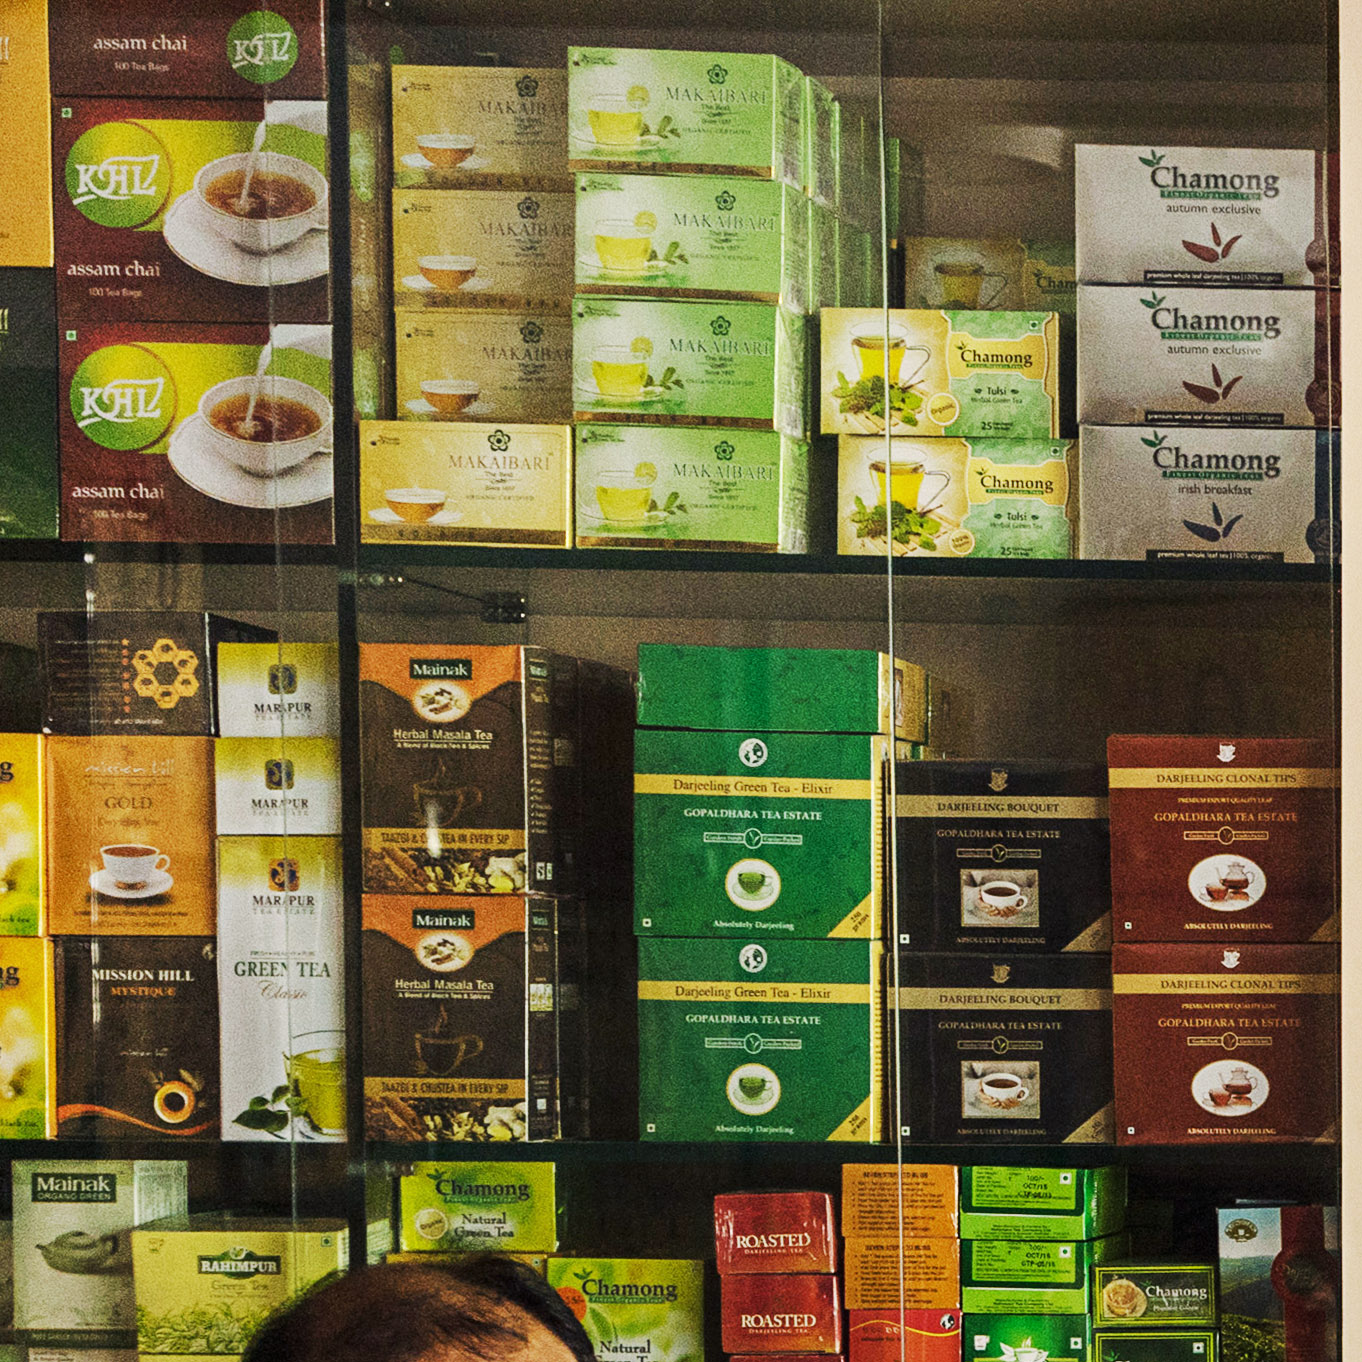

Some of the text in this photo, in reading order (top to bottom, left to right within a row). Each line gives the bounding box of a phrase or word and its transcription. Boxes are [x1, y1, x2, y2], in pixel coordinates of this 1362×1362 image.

[1151, 168, 1280, 197] Chamong
[1167, 204, 1261, 215] autumn exclusive
[67, 260, 161, 278] assam chai
[960, 349, 1033, 369] Chamong
[986, 386, 1007, 397] Tulsi
[448, 455, 549, 471] MAKAIBARI
[72, 482, 165, 500] assam chai
[1178, 484, 1252, 496] irish breakfast
[414, 662, 469, 679] Mainak
[394, 728, 493, 742] Herbal Masala Tea
[673, 779, 833, 796] Darjeeling Green Tea Elixir
[104, 796, 152, 809] GOLD
[938, 802, 1059, 814] DARJEELING BOUQUET
[683, 807, 822, 820] GOPALDHARA TEA ESTATE
[713, 919, 794, 932] Absolutely Darjeeling
[93, 970, 194, 982] MISSION HILL
[1161, 979, 1226, 990] DARJEELING
[1230, 979, 1269, 990] CLONAL
[111, 987, 176, 997] MYSTIQUE
[37, 1174, 111, 1192] Mainak
[435, 1179, 529, 1201] Chamong
[462, 1214, 506, 1225] Natural
[454, 1226, 514, 1238] Green Tea
[201, 1260, 277, 1273] RAHIMPUR
